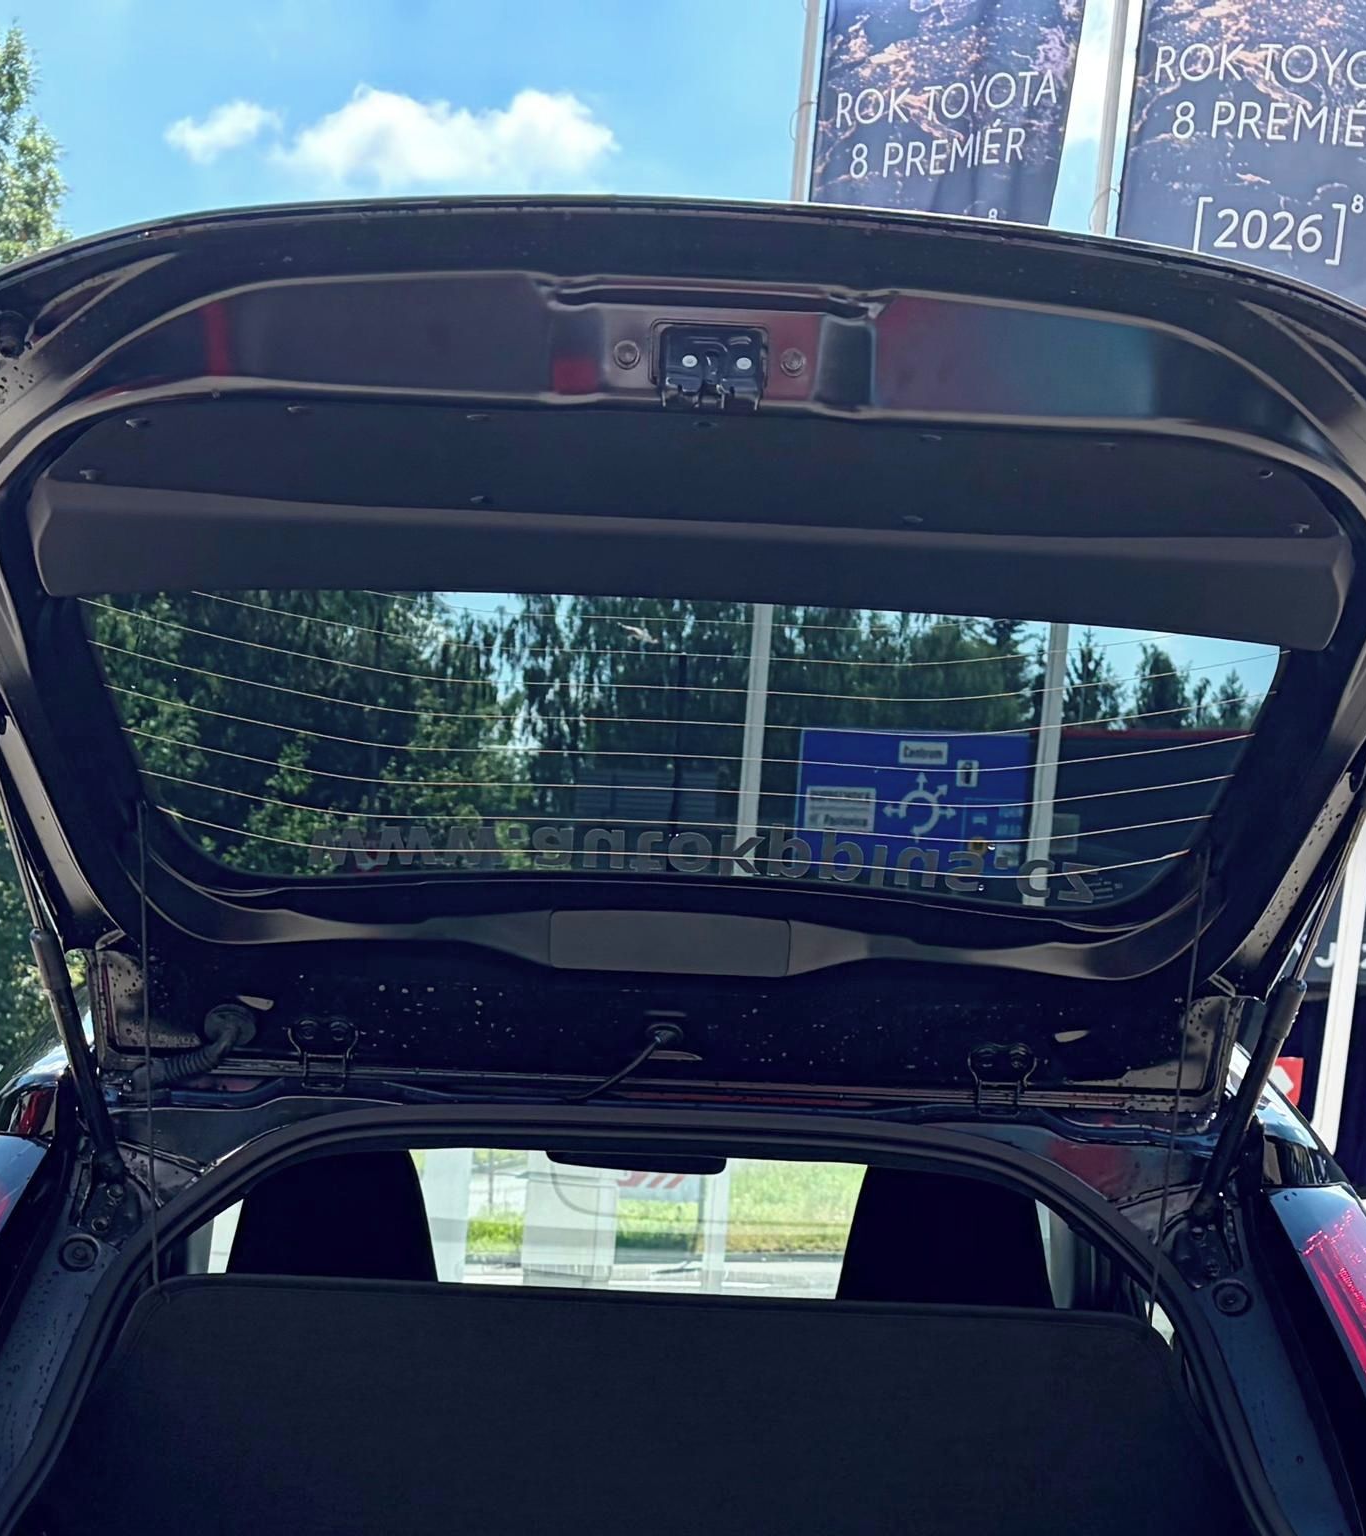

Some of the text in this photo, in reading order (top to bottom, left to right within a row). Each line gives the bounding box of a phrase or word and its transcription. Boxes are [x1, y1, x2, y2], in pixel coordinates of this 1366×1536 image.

[1154, 43, 1245, 83] ROK
[836, 69, 1057, 128] ROK TOYOTA
[1172, 101, 1195, 139] 8
[850, 119, 1026, 179] 8 PREMIÉR
